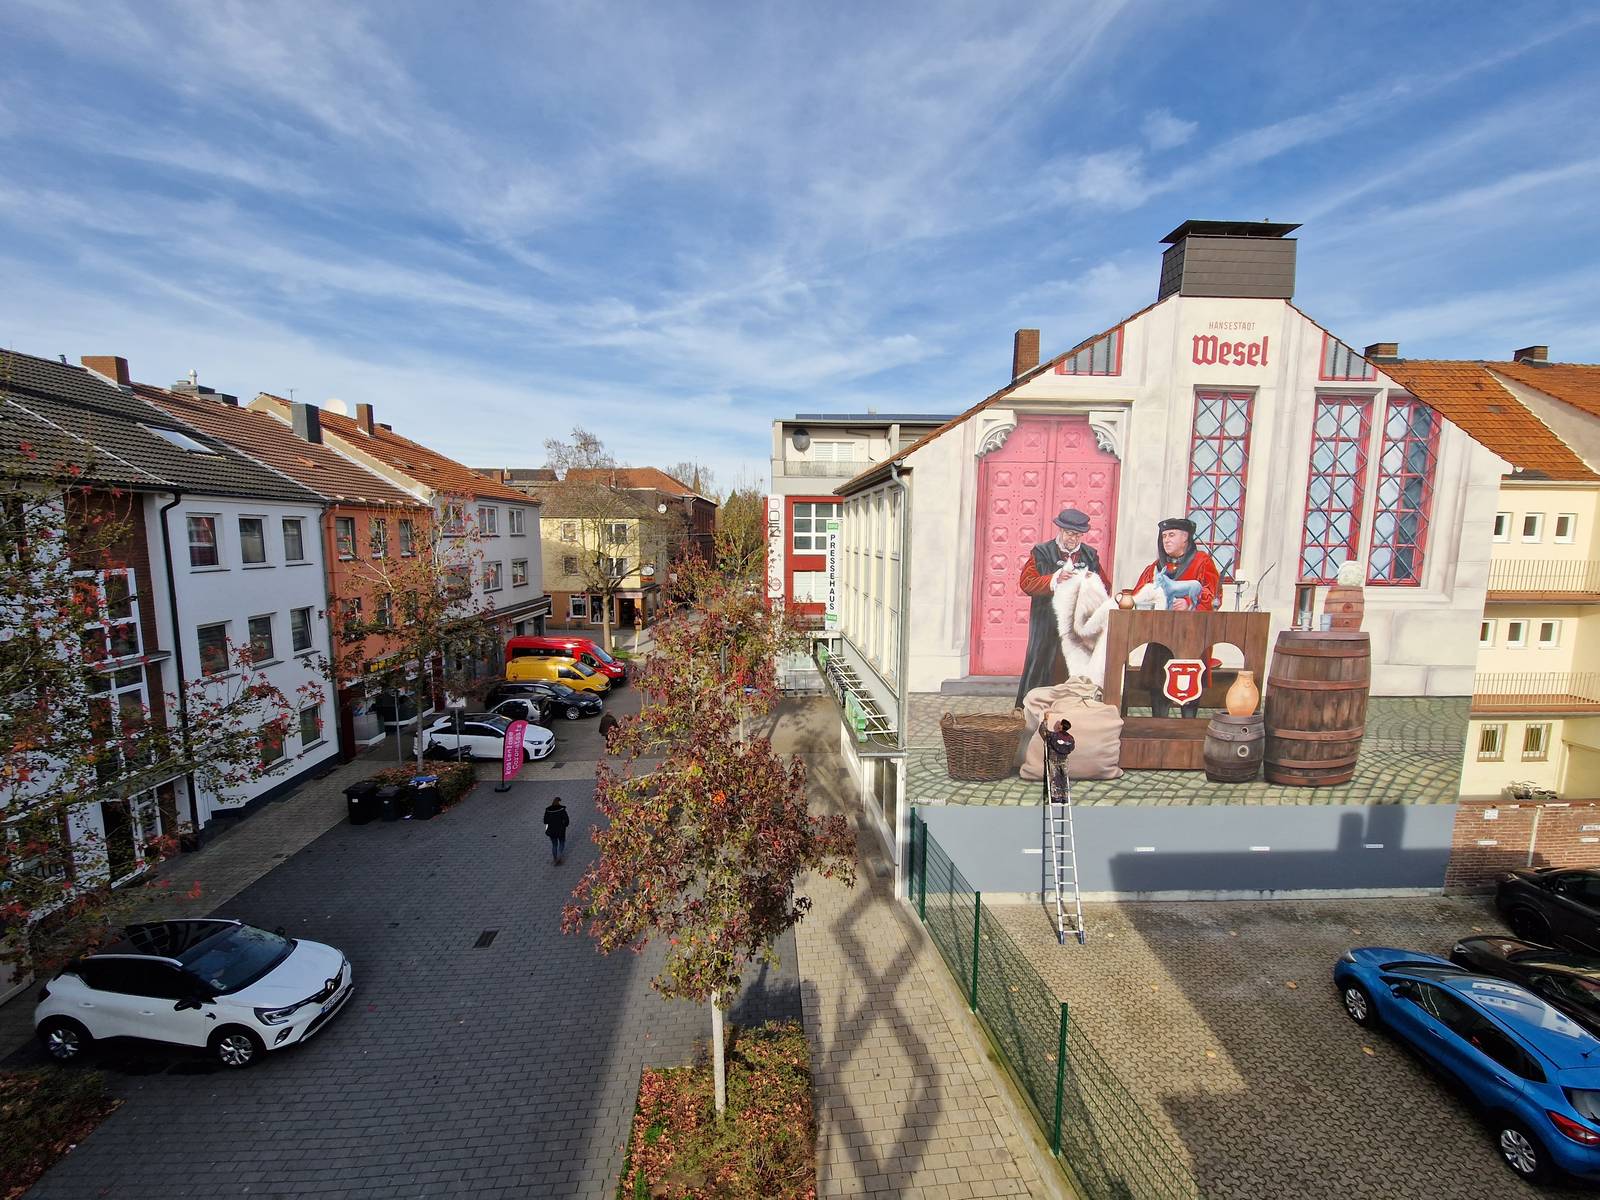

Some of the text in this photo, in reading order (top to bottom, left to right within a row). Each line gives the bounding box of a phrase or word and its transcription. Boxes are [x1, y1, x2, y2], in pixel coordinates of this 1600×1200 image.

[1208, 321, 1256, 331] HANSESTADT
[1192, 334, 1269, 367] Wesel
[505, 731, 514, 775] kostenlose
